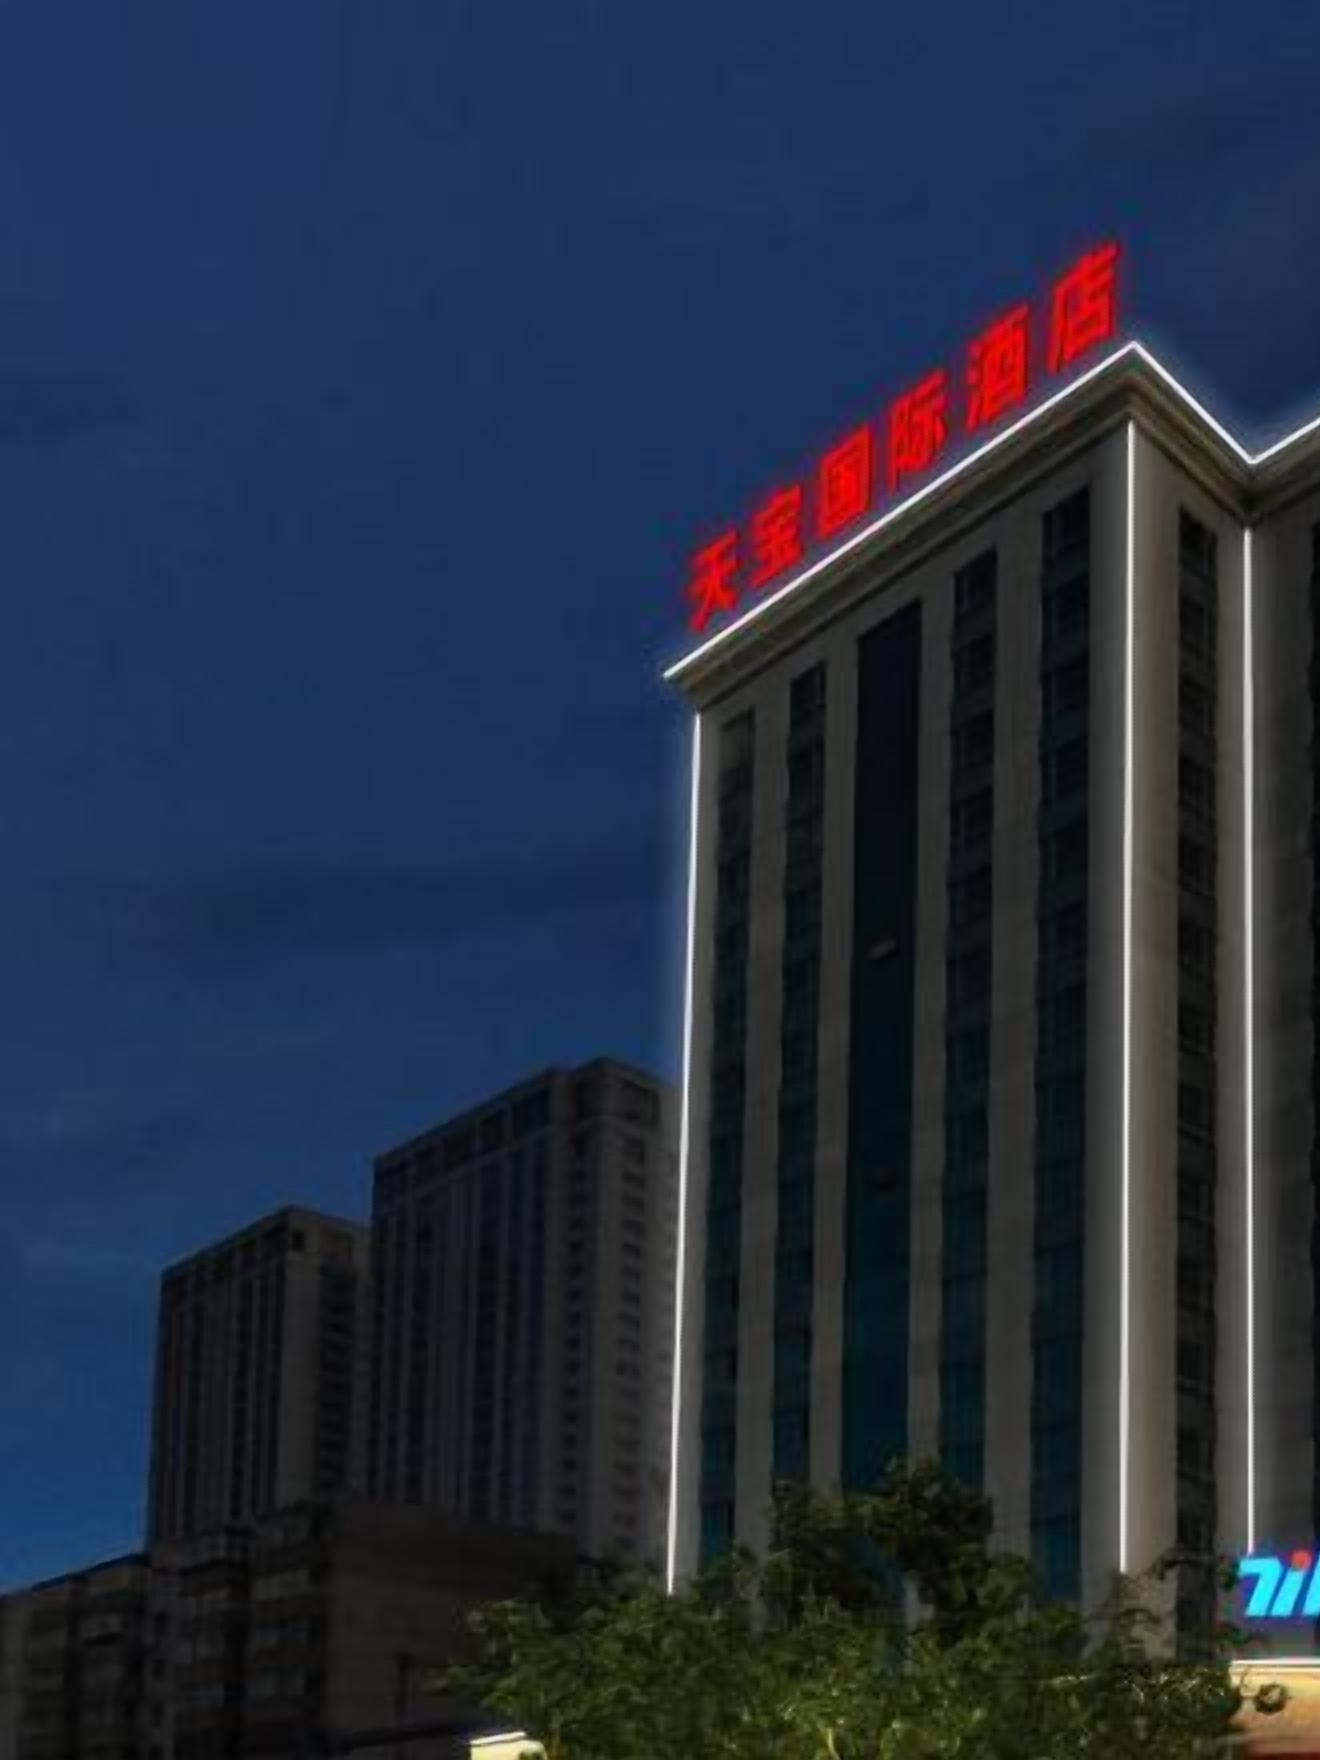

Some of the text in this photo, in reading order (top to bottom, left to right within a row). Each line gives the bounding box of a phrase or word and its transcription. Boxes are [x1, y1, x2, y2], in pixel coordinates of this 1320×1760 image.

[690, 243, 1119, 631] 天宝国际酒店
